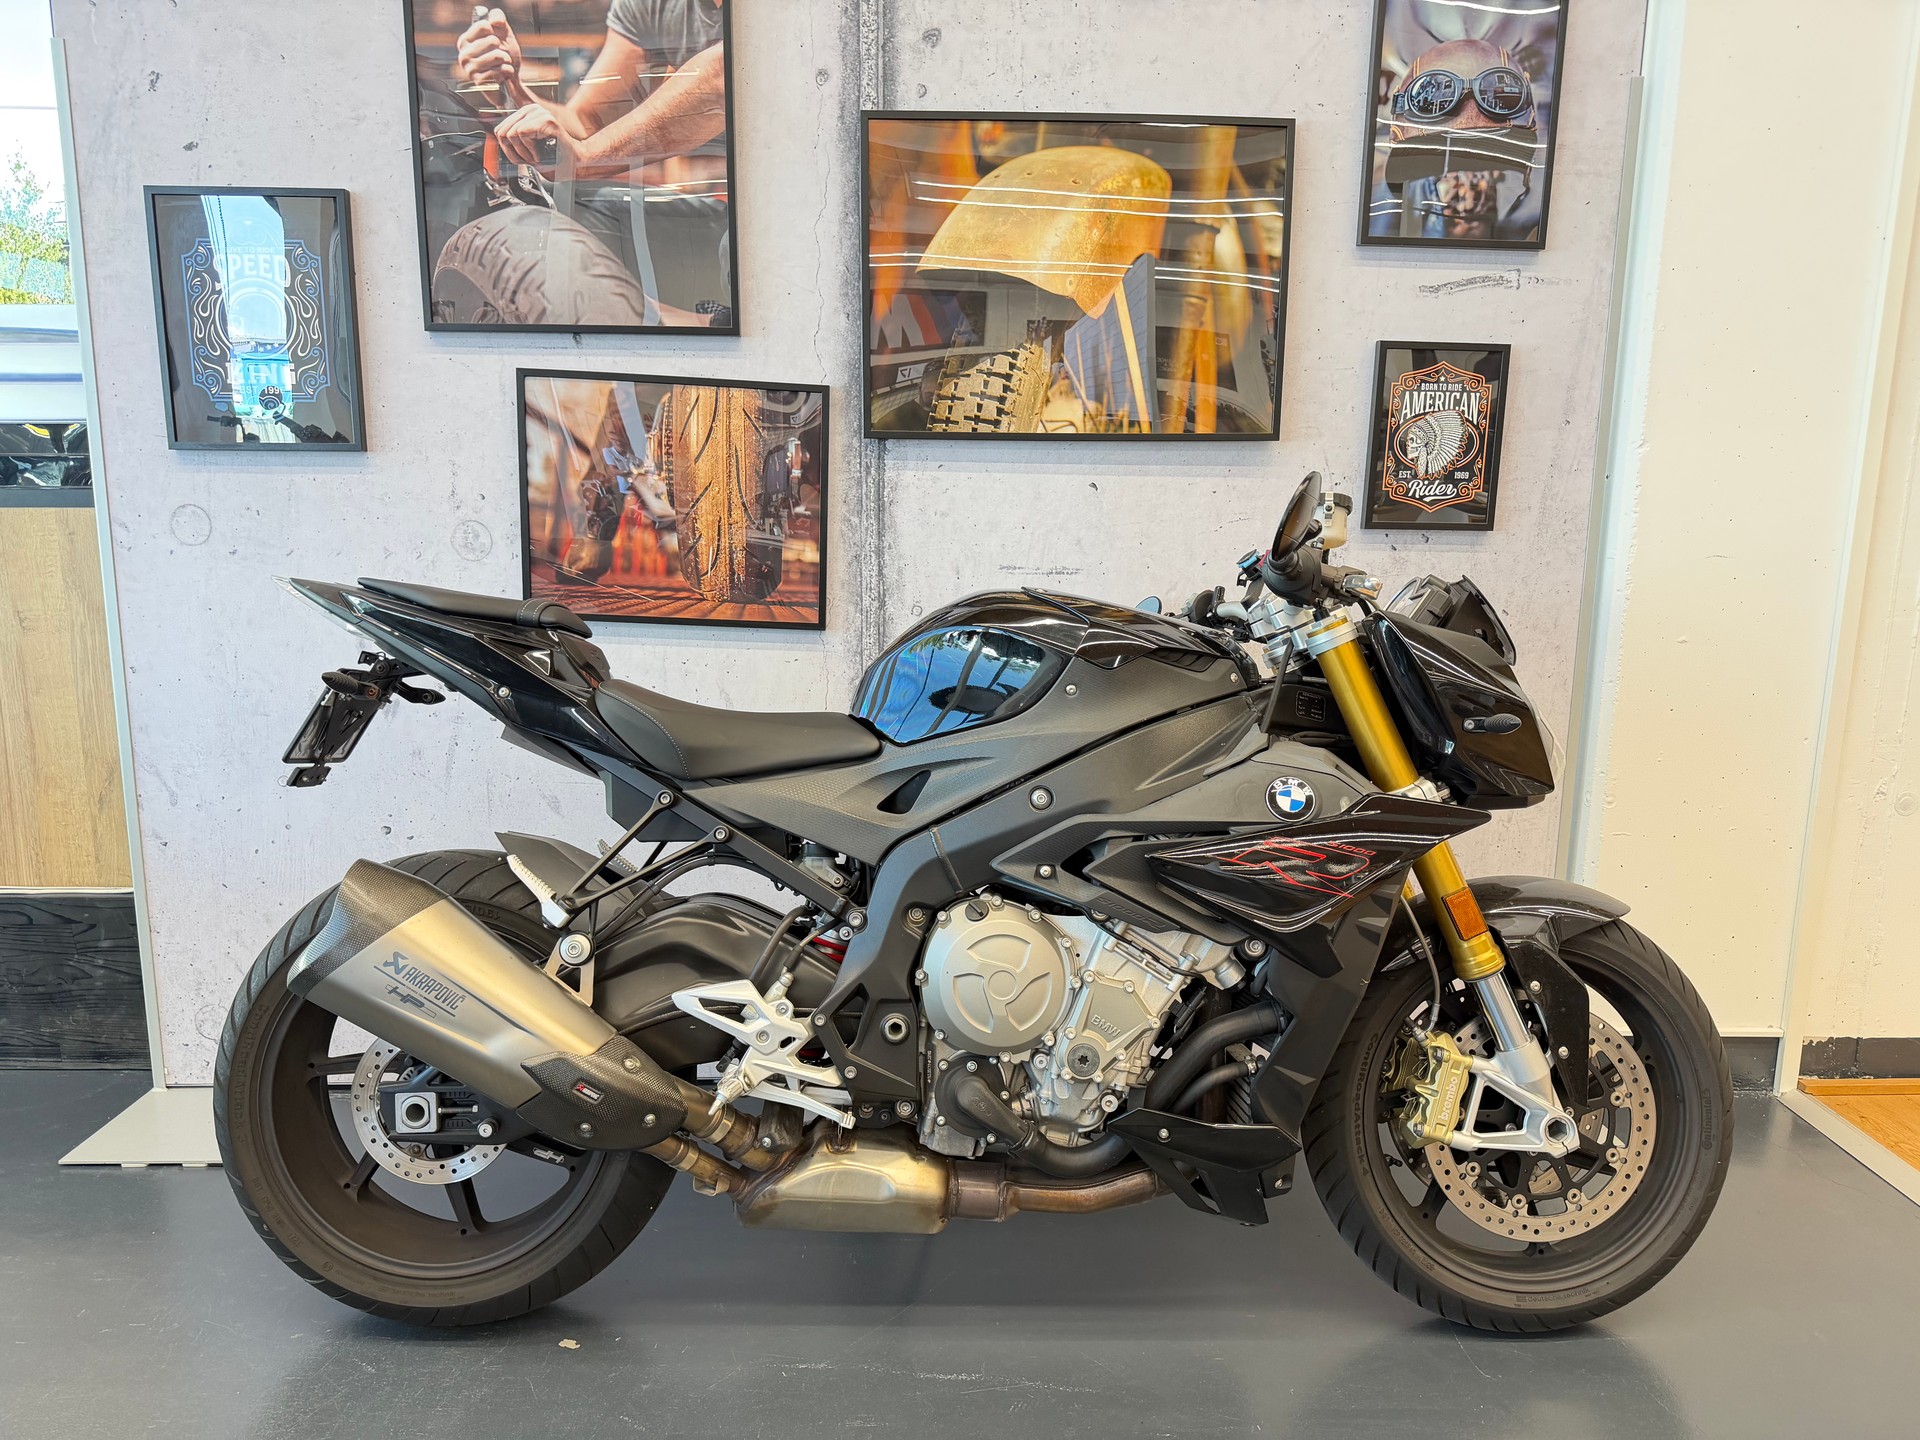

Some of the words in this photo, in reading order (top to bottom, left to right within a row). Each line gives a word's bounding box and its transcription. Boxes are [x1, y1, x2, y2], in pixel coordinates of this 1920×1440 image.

[1421, 383, 1438, 391] BORN
[1439, 383, 1447, 391] TO
[1448, 384, 1463, 392] RIDE
[1400, 390, 1481, 425] AMERICAN
[1398, 470, 1412, 479] EST.
[1408, 479, 1457, 500] Rider
[1090, 1013, 1122, 1038] BMW
[1438, 1076, 1459, 1122] brembo
